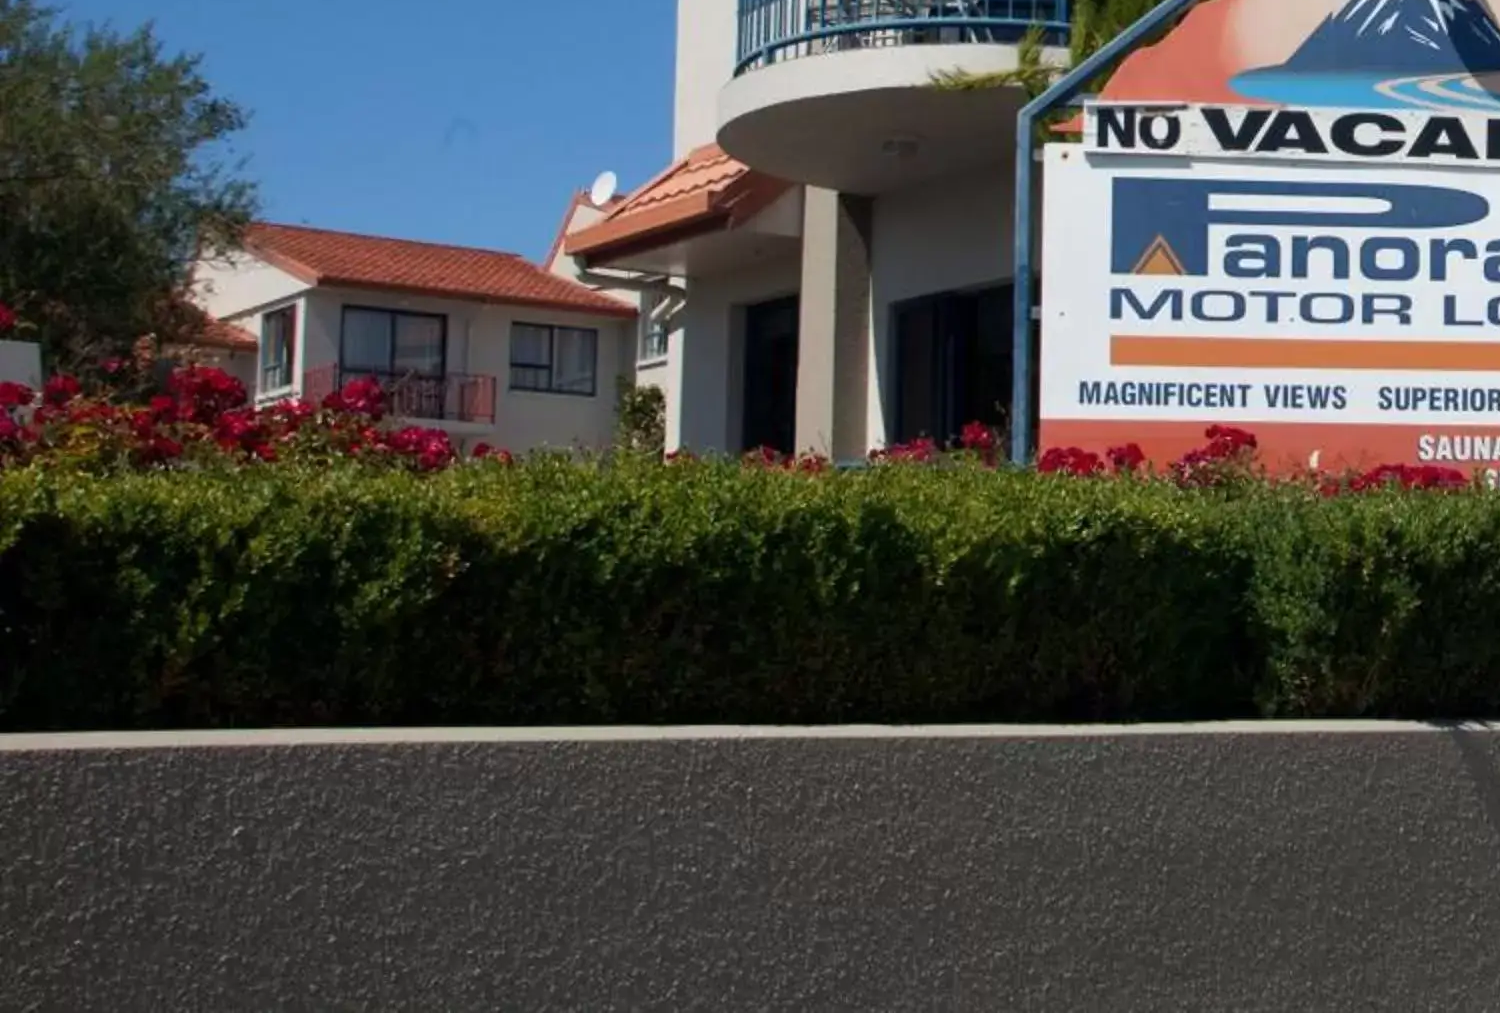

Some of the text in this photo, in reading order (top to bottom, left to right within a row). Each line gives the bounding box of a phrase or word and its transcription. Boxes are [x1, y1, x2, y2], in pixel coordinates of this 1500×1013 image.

[1096, 106, 1181, 150] NO
[1110, 288, 1412, 325] MOTOR
[1078, 381, 1252, 408] MAGNIFICENT
[1264, 384, 1348, 410] VIEWS
